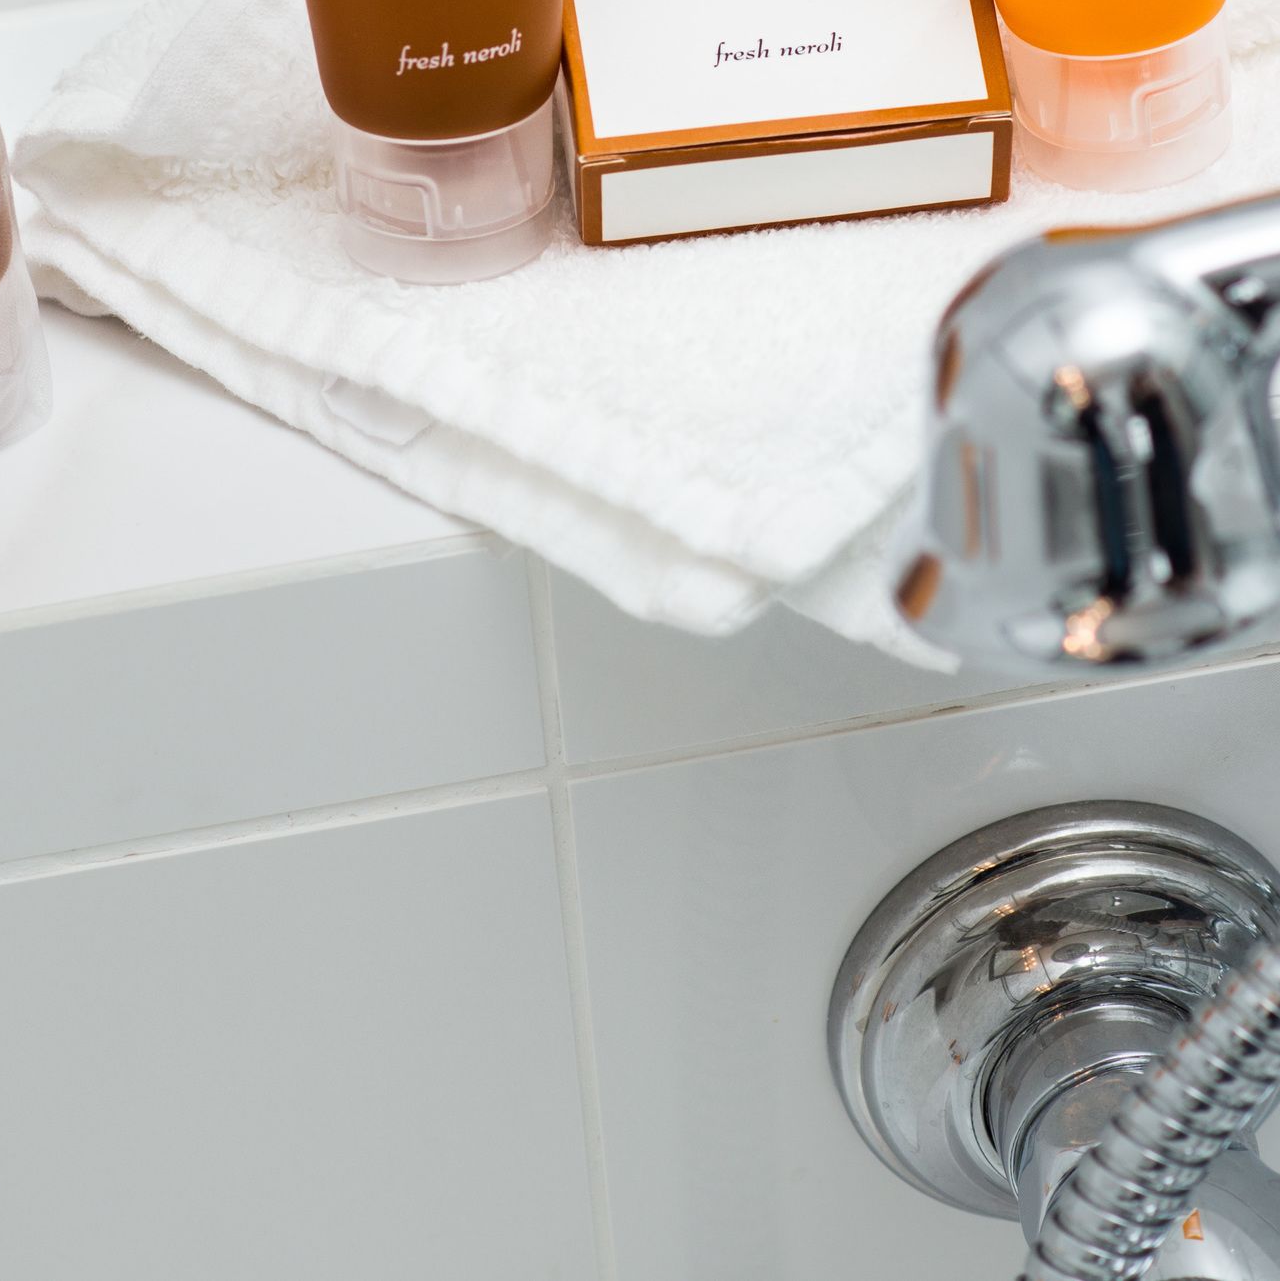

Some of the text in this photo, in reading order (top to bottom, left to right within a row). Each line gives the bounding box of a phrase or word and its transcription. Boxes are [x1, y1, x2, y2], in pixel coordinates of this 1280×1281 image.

[396, 28, 522, 76] fresh neroli
[713, 32, 843, 68] fresh neroli
